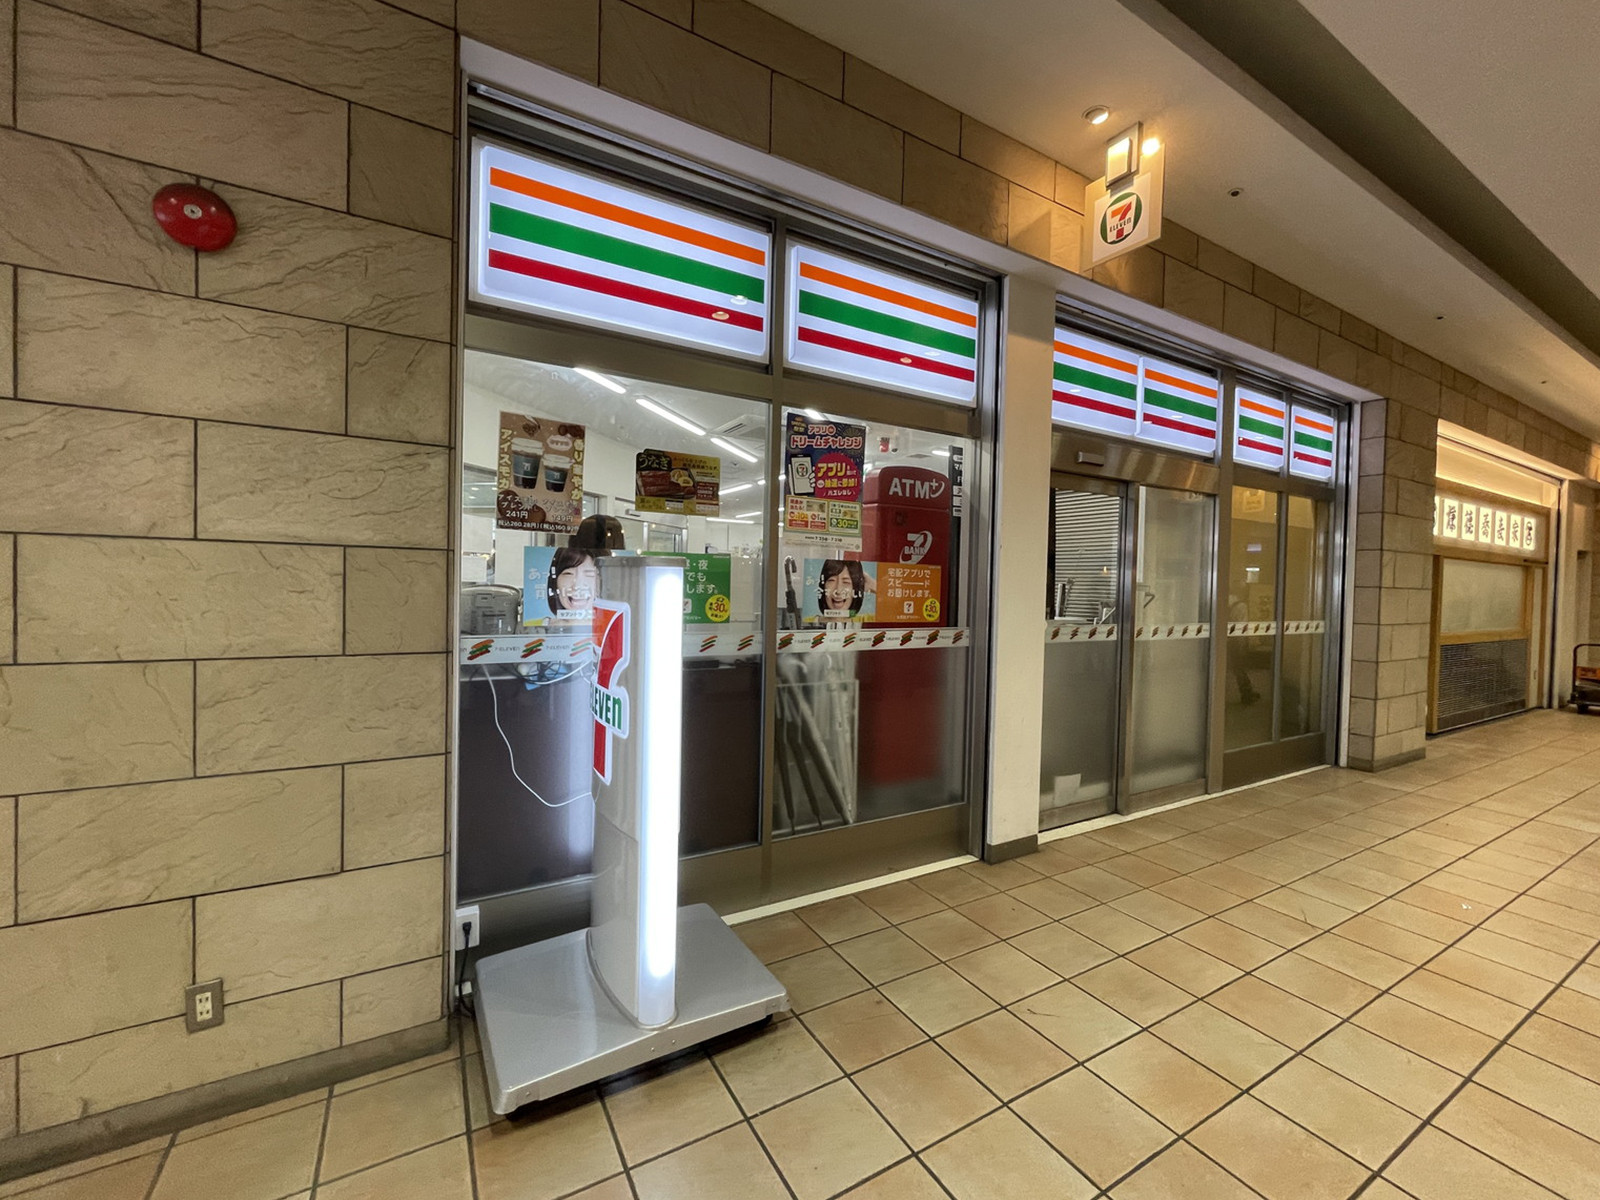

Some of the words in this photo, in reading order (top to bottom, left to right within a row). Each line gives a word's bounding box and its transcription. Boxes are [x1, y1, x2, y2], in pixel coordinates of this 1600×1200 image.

[1111, 201, 1132, 240] 7
[791, 435, 862, 449] ドリームチャレンジ
[500, 429, 512, 490] アイスモカ
[639, 453, 669, 470] うなぎ
[817, 462, 846, 477] アプリ
[506, 511, 528, 519] 241円
[904, 546, 926, 556] BANK
